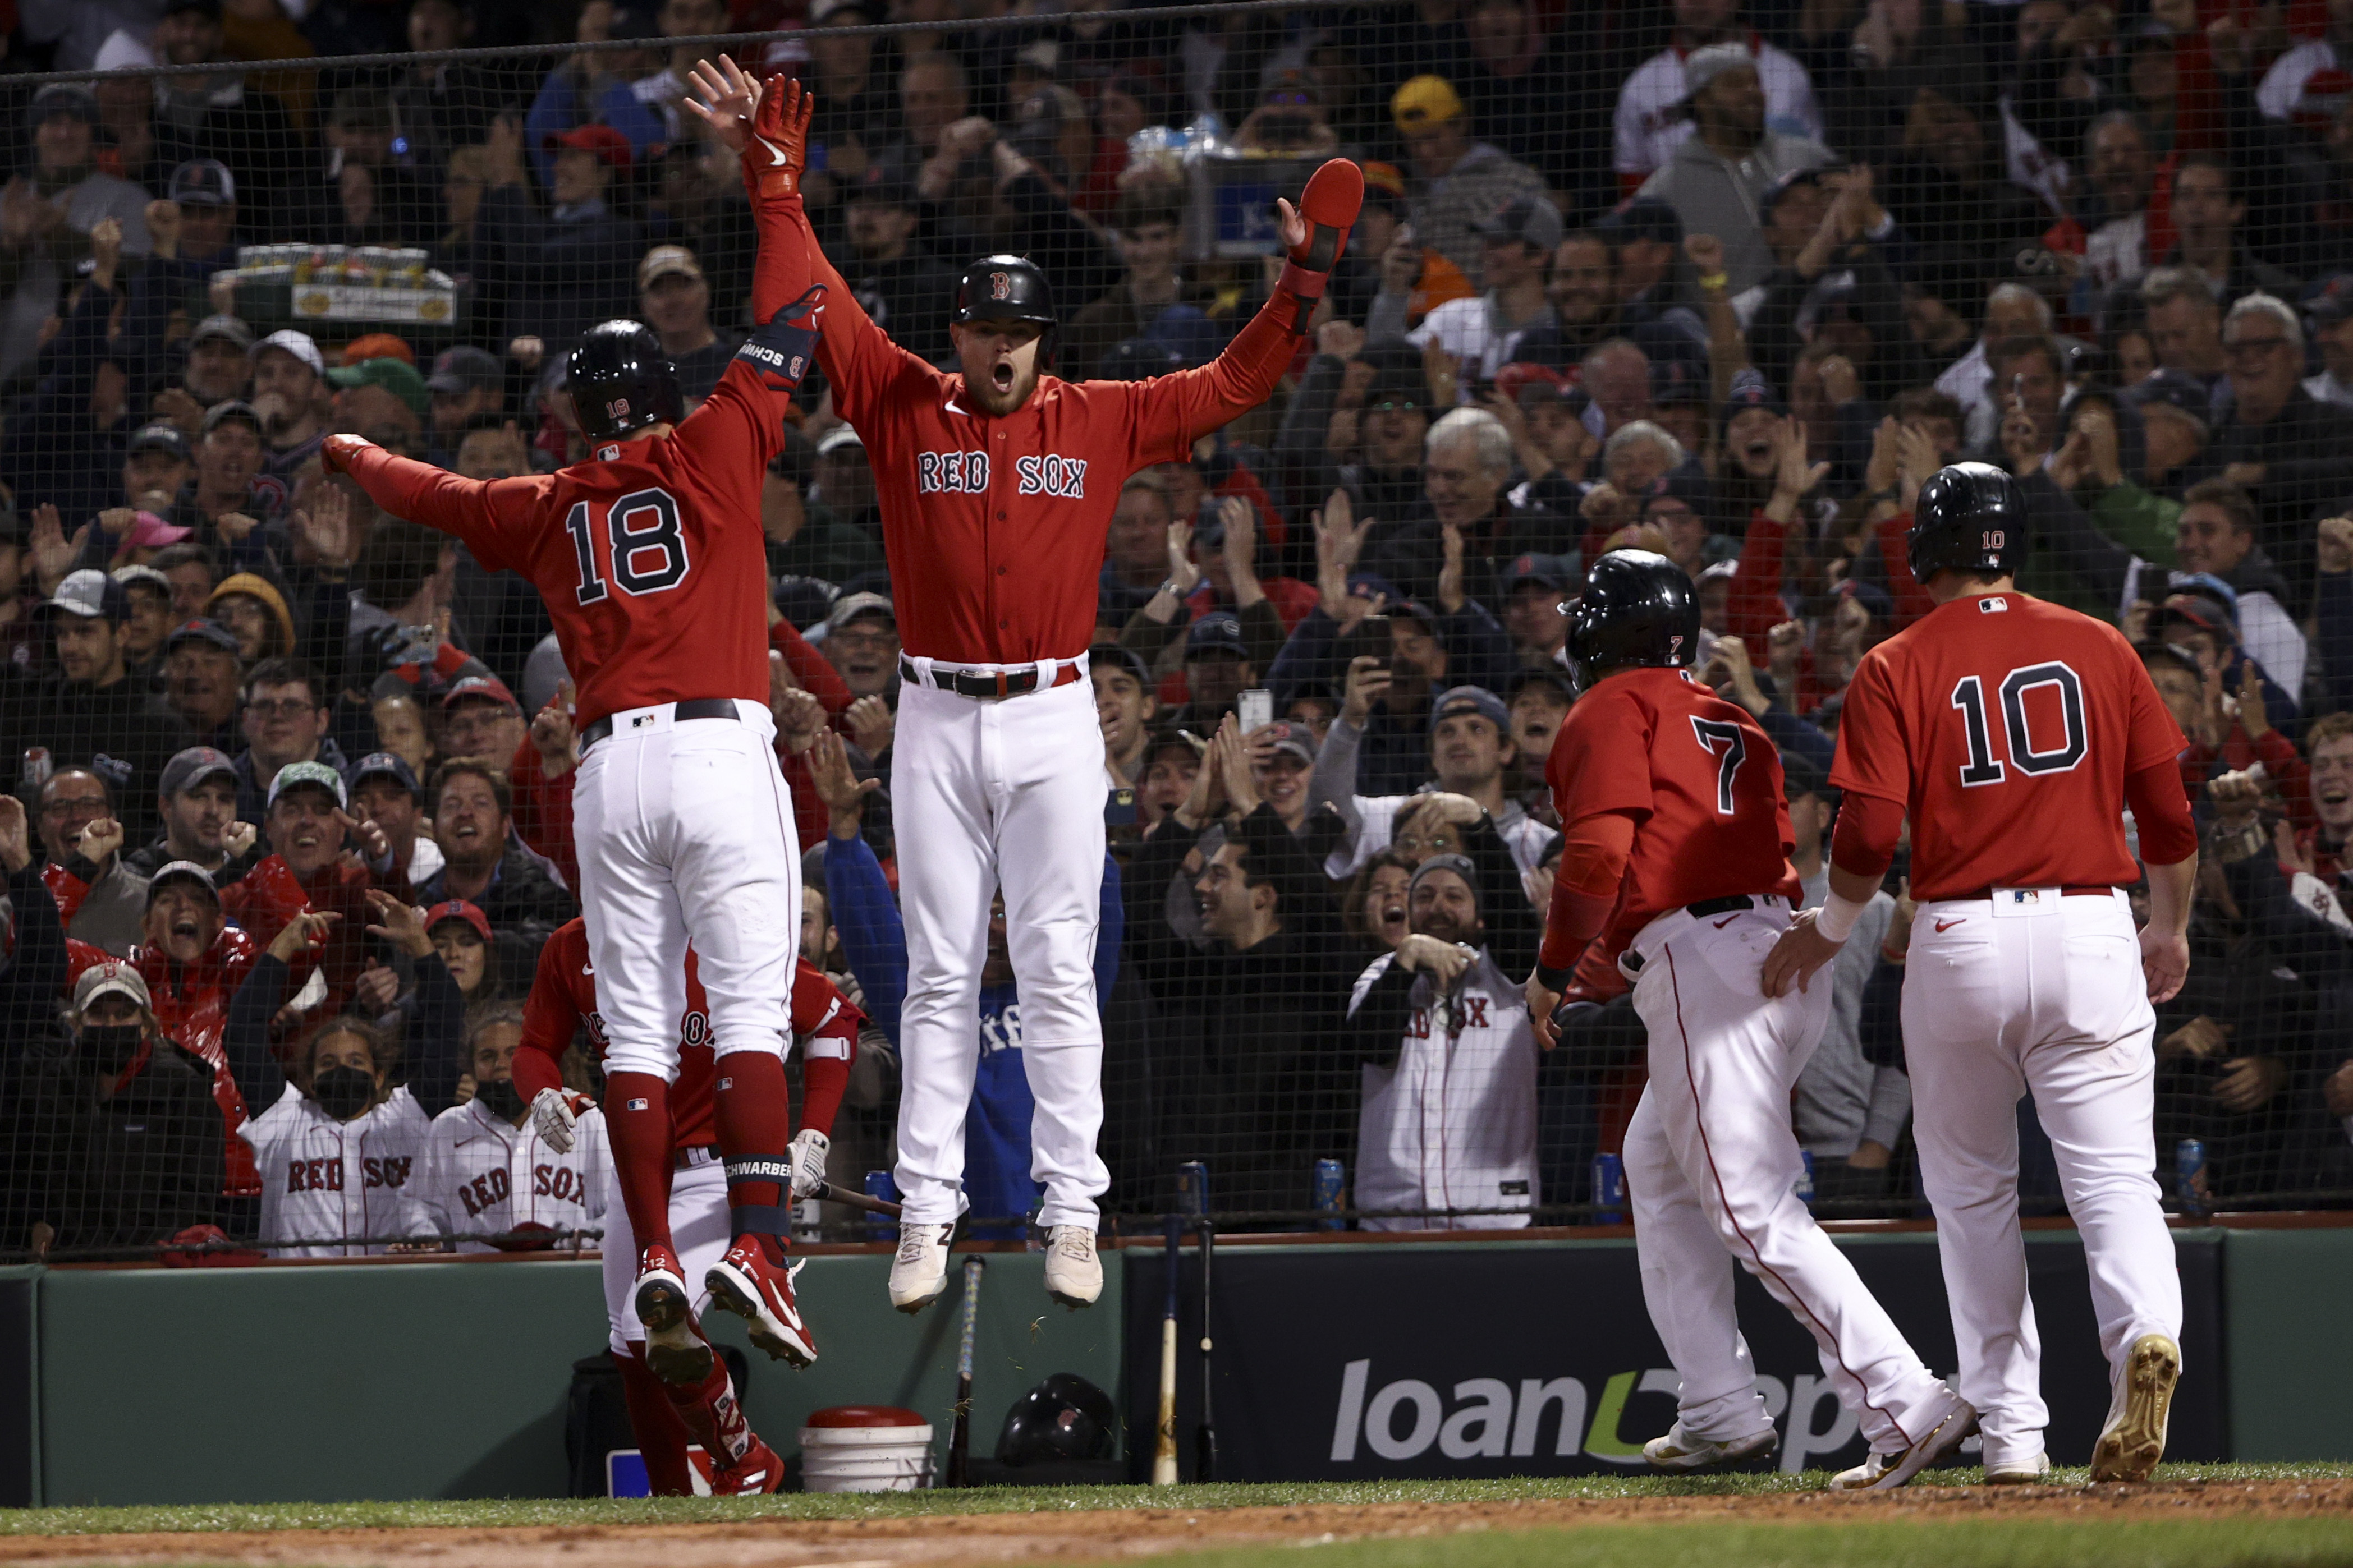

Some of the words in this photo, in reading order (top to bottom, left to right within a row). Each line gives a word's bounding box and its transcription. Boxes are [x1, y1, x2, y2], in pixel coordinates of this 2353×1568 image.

[989, 272, 1010, 300] B
[606, 398, 631, 419] 18
[918, 450, 990, 494] RED
[1016, 453, 1088, 499] SOX
[566, 486, 690, 606] 18
[1982, 530, 2005, 549] 10
[1670, 636, 1684, 654] 7
[1951, 660, 2088, 787] 10
[1689, 715, 1746, 815] 7
[288, 1157, 343, 1192] RED
[724, 1161, 792, 1177] CHWARBER
[458, 1167, 509, 1218] RED
[535, 1164, 585, 1207] SOX
[648, 1257, 666, 1267] 12
[728, 1247, 745, 1261] 12
